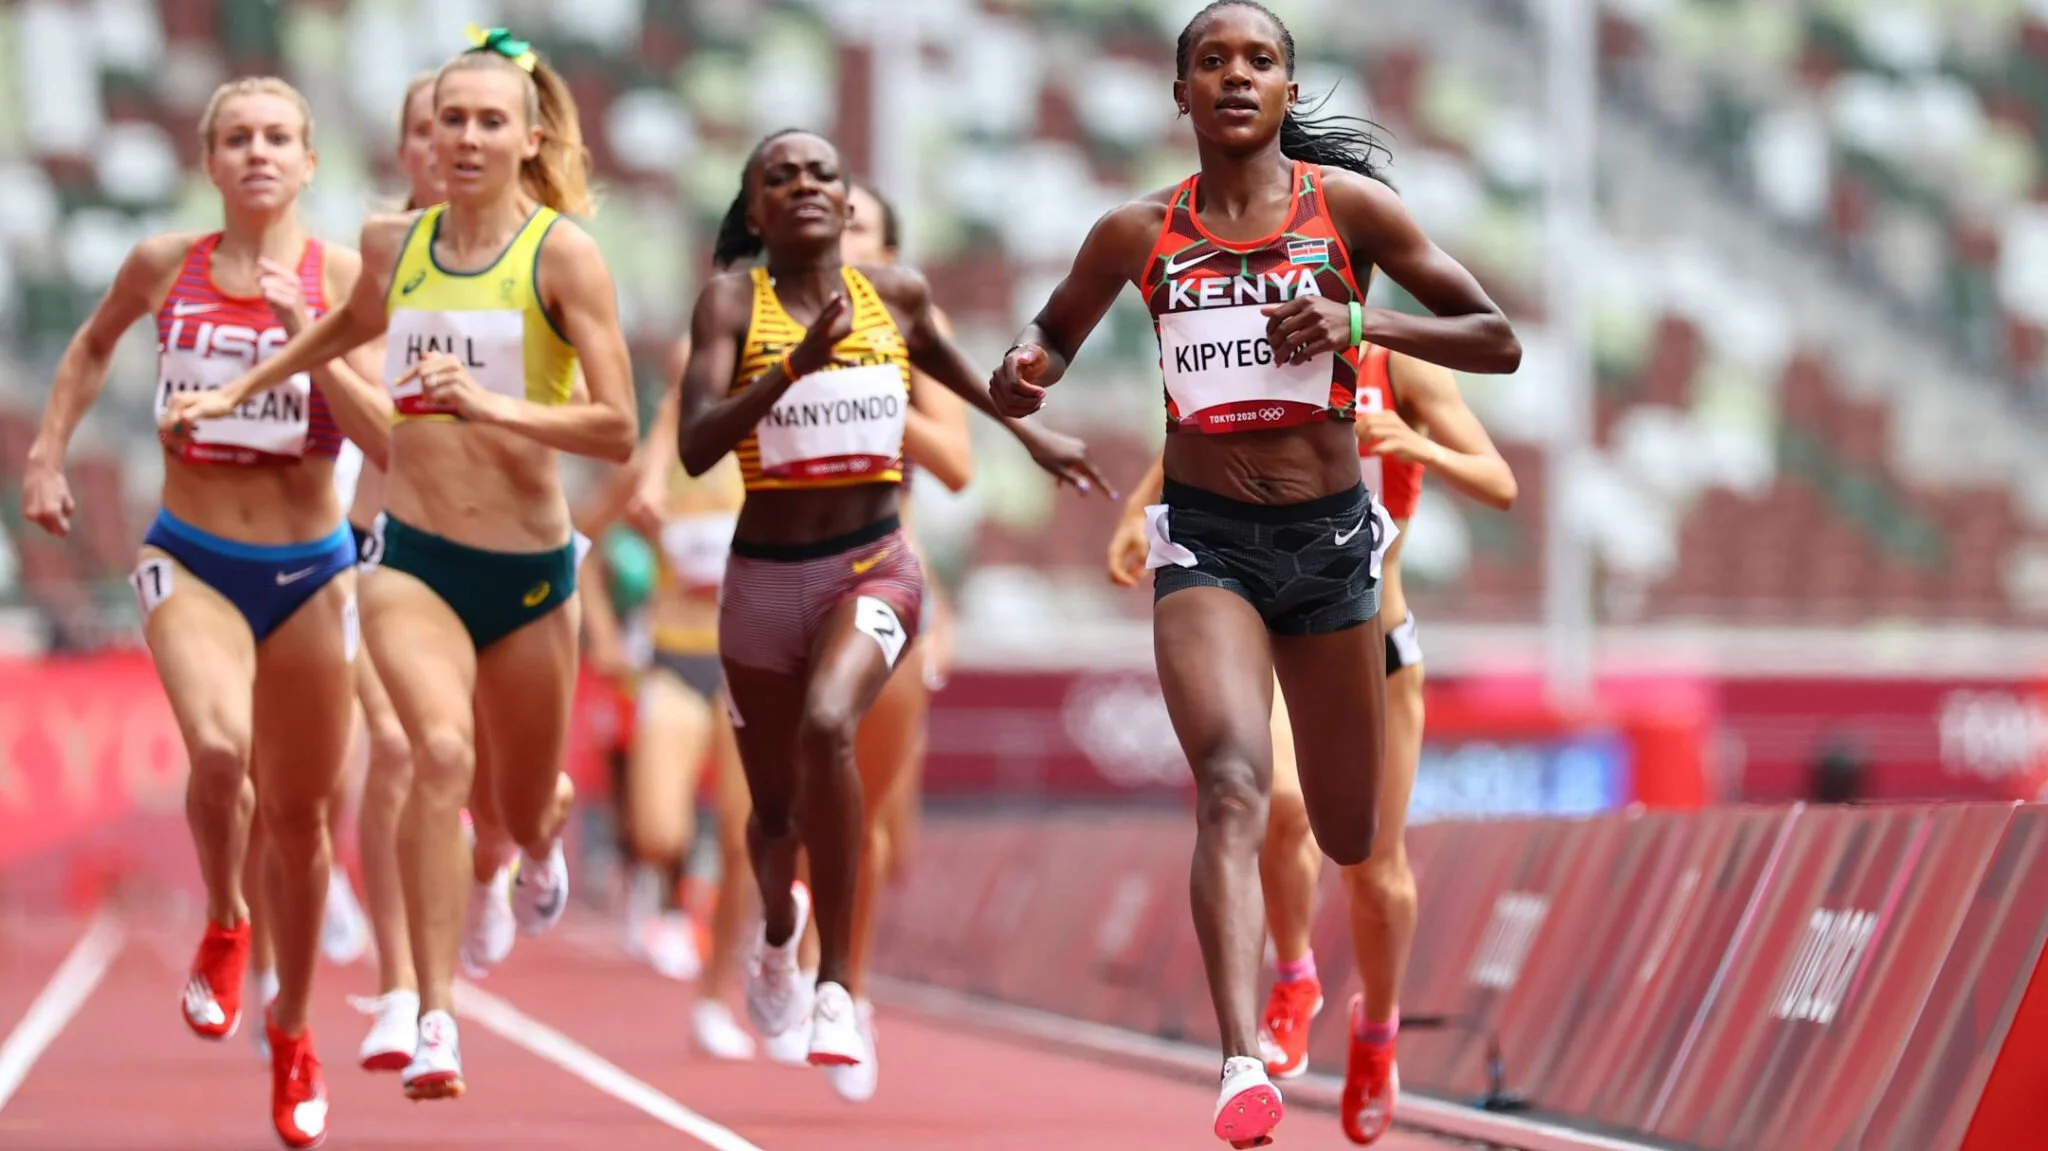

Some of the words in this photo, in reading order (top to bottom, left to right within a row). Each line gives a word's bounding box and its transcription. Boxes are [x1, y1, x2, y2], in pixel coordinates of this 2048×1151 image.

[1168, 267, 1323, 309] KENYA
[1175, 336, 1312, 374] KIPYEG
[766, 394, 899, 428] NANYONDO
[1209, 413, 1236, 424] TOKYO
[1237, 411, 1257, 421] 2020
